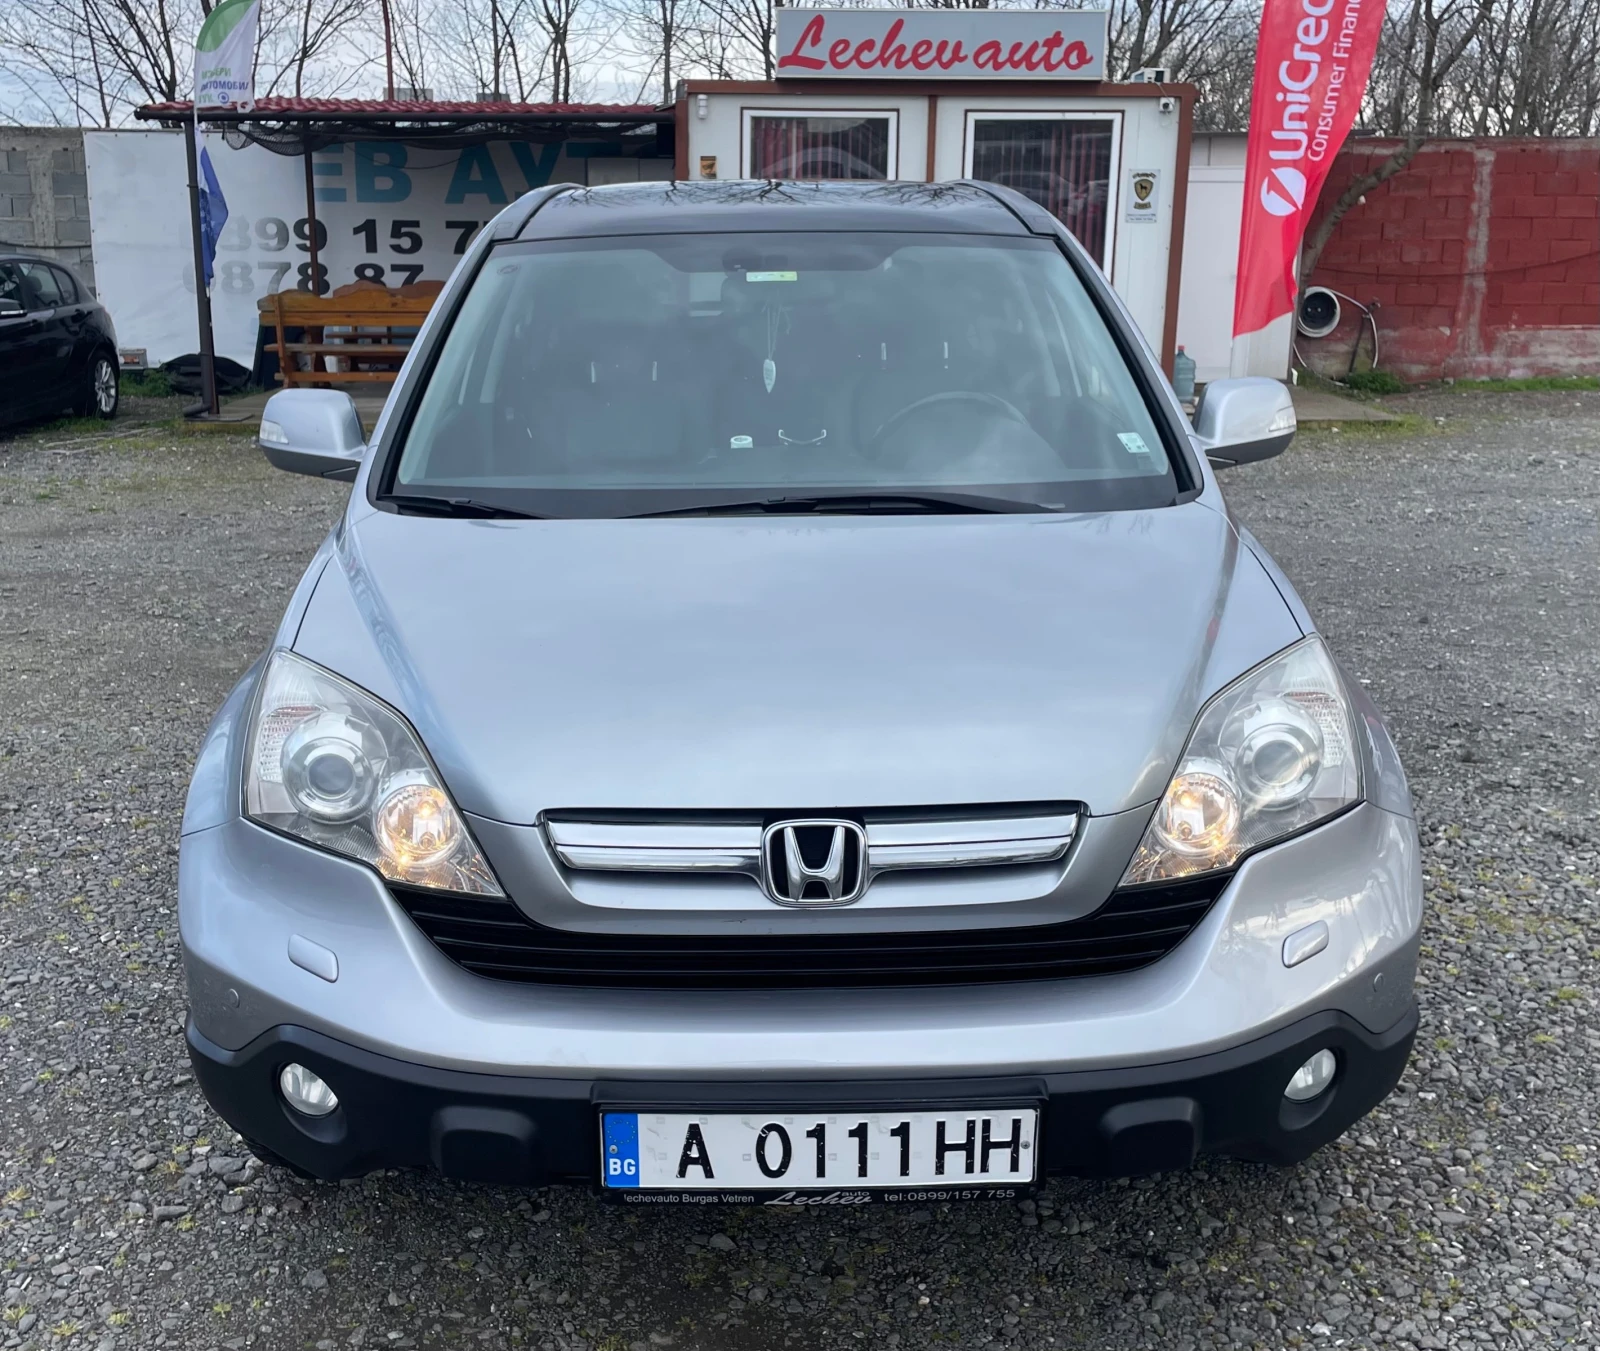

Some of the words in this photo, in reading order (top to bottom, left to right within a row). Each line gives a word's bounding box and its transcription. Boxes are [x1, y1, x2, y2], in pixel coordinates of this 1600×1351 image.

[778, 14, 968, 71] Lechev
[973, 30, 1094, 72] auto
[1308, 63, 1346, 161] Consumer
[353, 218, 423, 254] 15
[676, 1122, 715, 1179] A
[609, 1158, 636, 1176] BG
[682, 1193, 719, 1205] Burgas
[721, 1193, 755, 1204] Vetren
[764, 1191, 873, 1206] Lechev
[884, 1190, 981, 1202] tel:0899/157
[987, 1189, 1016, 1199] 755
